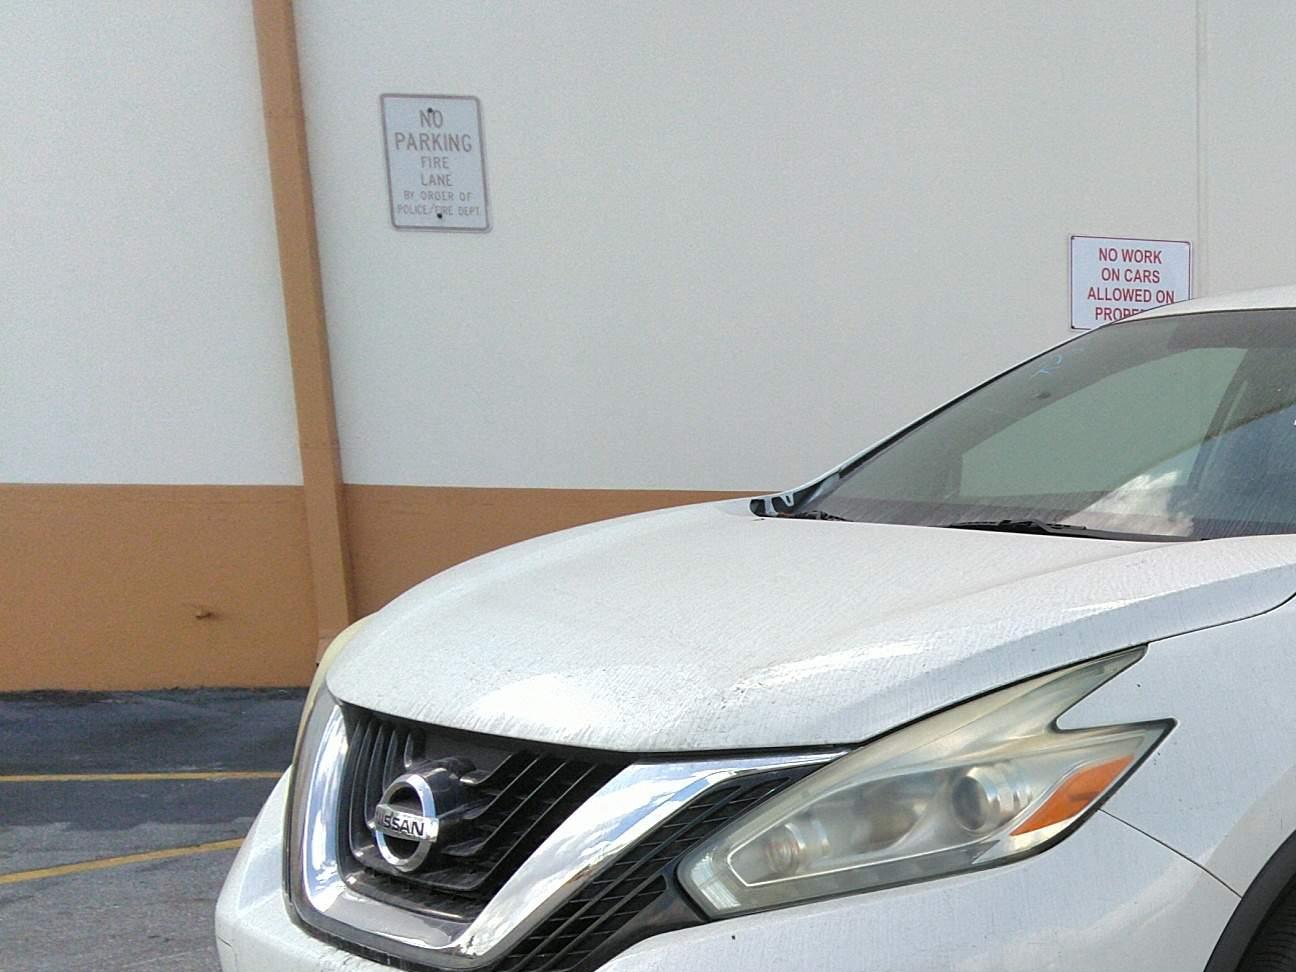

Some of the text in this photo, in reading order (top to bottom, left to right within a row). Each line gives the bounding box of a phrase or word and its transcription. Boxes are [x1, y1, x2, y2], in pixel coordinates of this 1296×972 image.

[419, 109, 444, 129] NO
[394, 132, 472, 152] PARKING
[420, 156, 449, 169] FIRE
[420, 174, 454, 186] LANE
[403, 190, 472, 202] BY ORDER OF
[1098, 247, 1162, 264] NO WORK
[1101, 267, 1160, 283] ON CARS
[1087, 286, 1175, 304] ALLOWED ON
